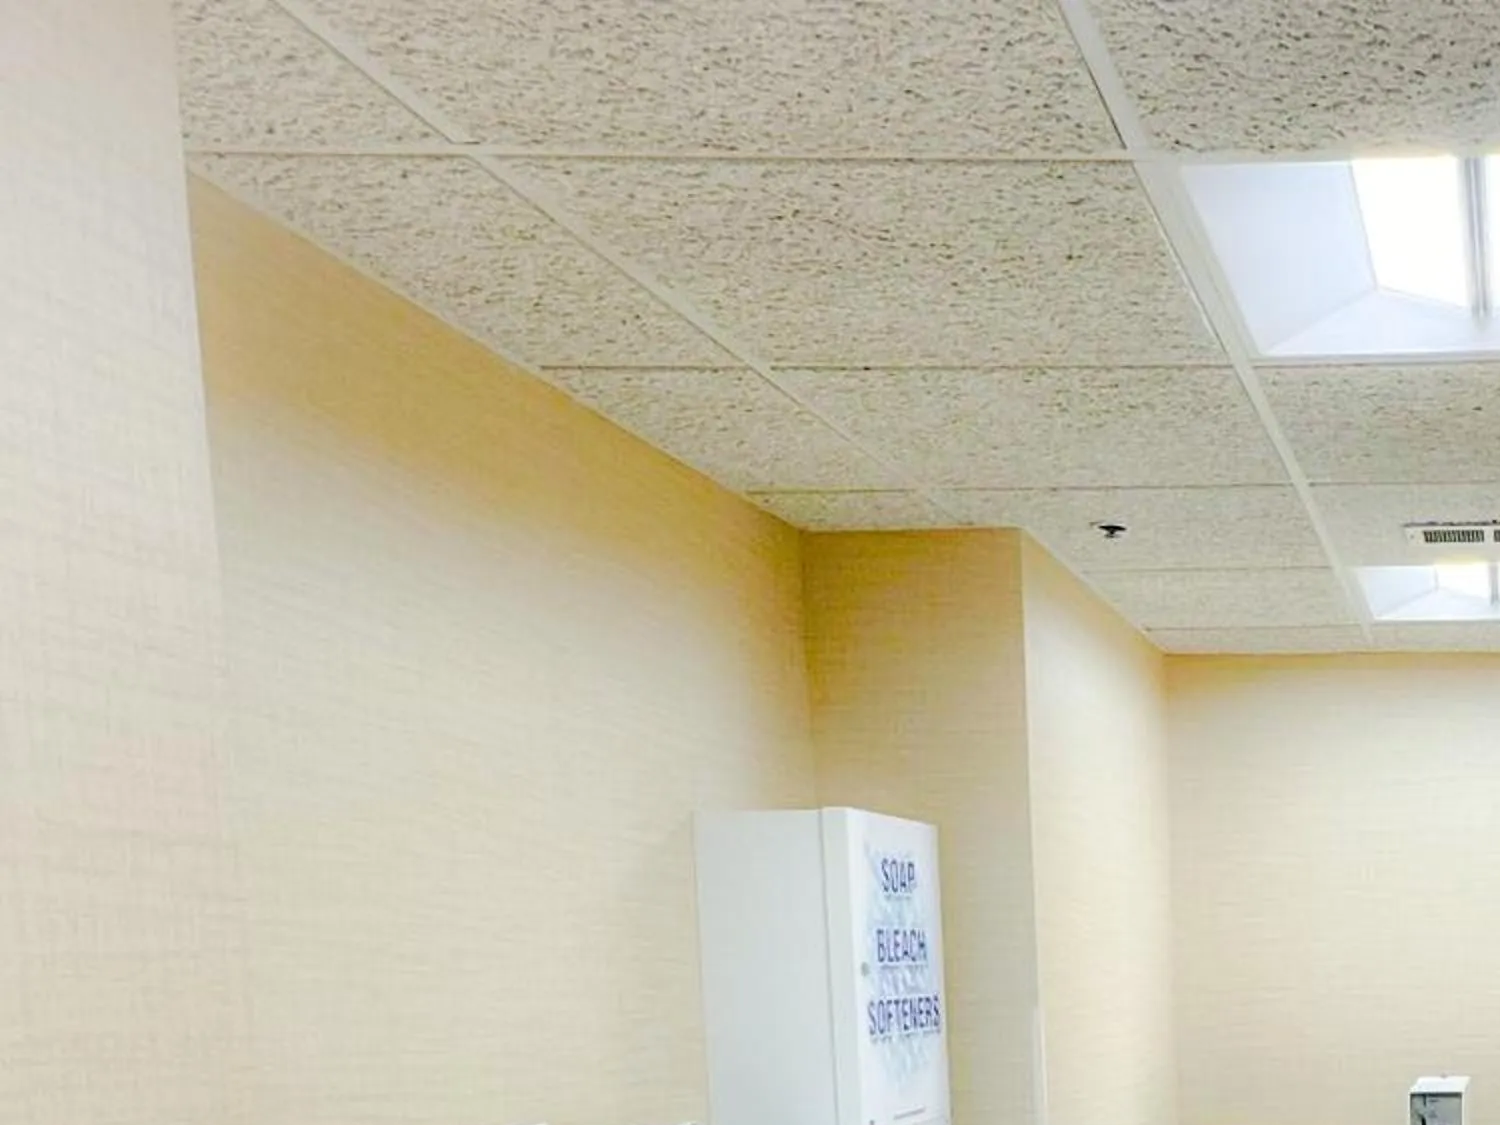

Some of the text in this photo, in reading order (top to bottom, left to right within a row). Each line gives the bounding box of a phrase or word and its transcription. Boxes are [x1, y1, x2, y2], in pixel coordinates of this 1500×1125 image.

[881, 857, 916, 893] SOAP
[876, 928, 927, 963] BLEACH
[867, 993, 941, 1036] SOFTENERS
